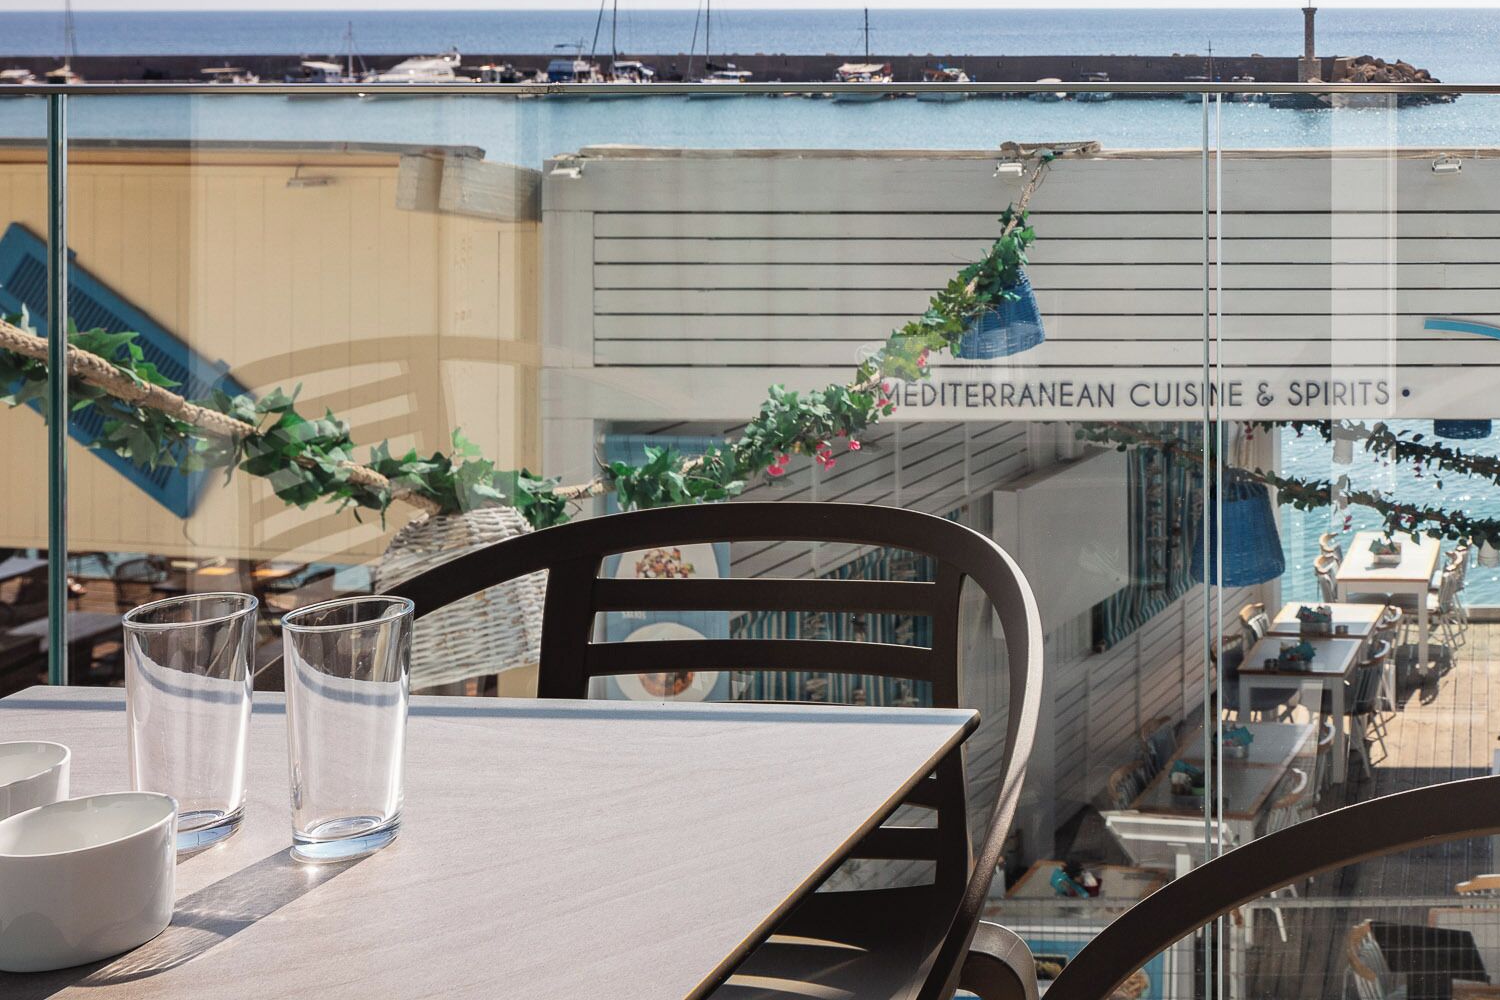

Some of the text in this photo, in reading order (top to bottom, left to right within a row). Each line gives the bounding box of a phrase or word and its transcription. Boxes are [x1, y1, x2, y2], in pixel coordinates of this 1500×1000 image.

[878, 381, 1391, 408] MEDITERRANEAN CUISINE & SPIRITS
